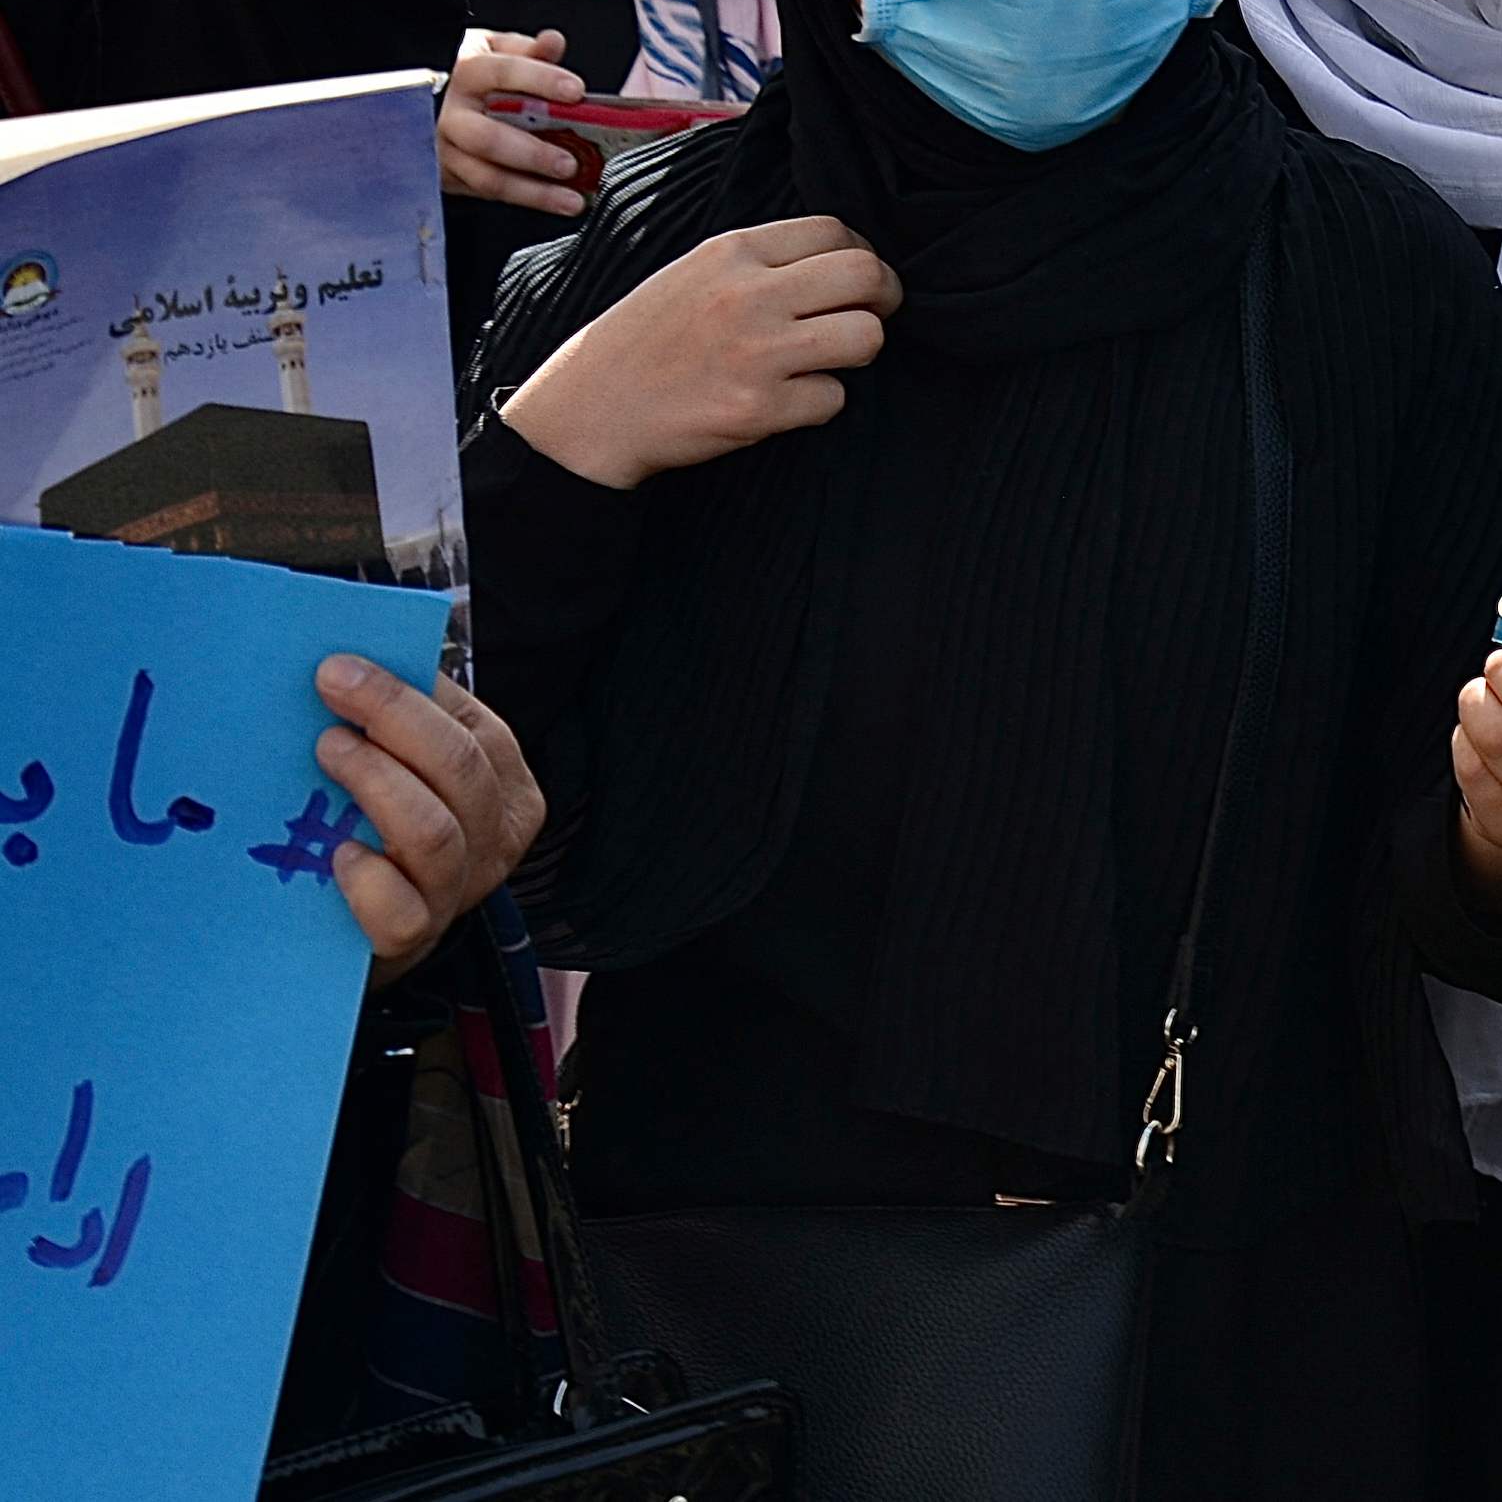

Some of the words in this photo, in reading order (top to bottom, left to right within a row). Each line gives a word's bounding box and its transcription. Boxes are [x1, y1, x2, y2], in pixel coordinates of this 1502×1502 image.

[318, 260, 383, 305] تعلیم
[108, 285, 213, 339] اسلامی
[163, 333, 228, 365] یازدهم
